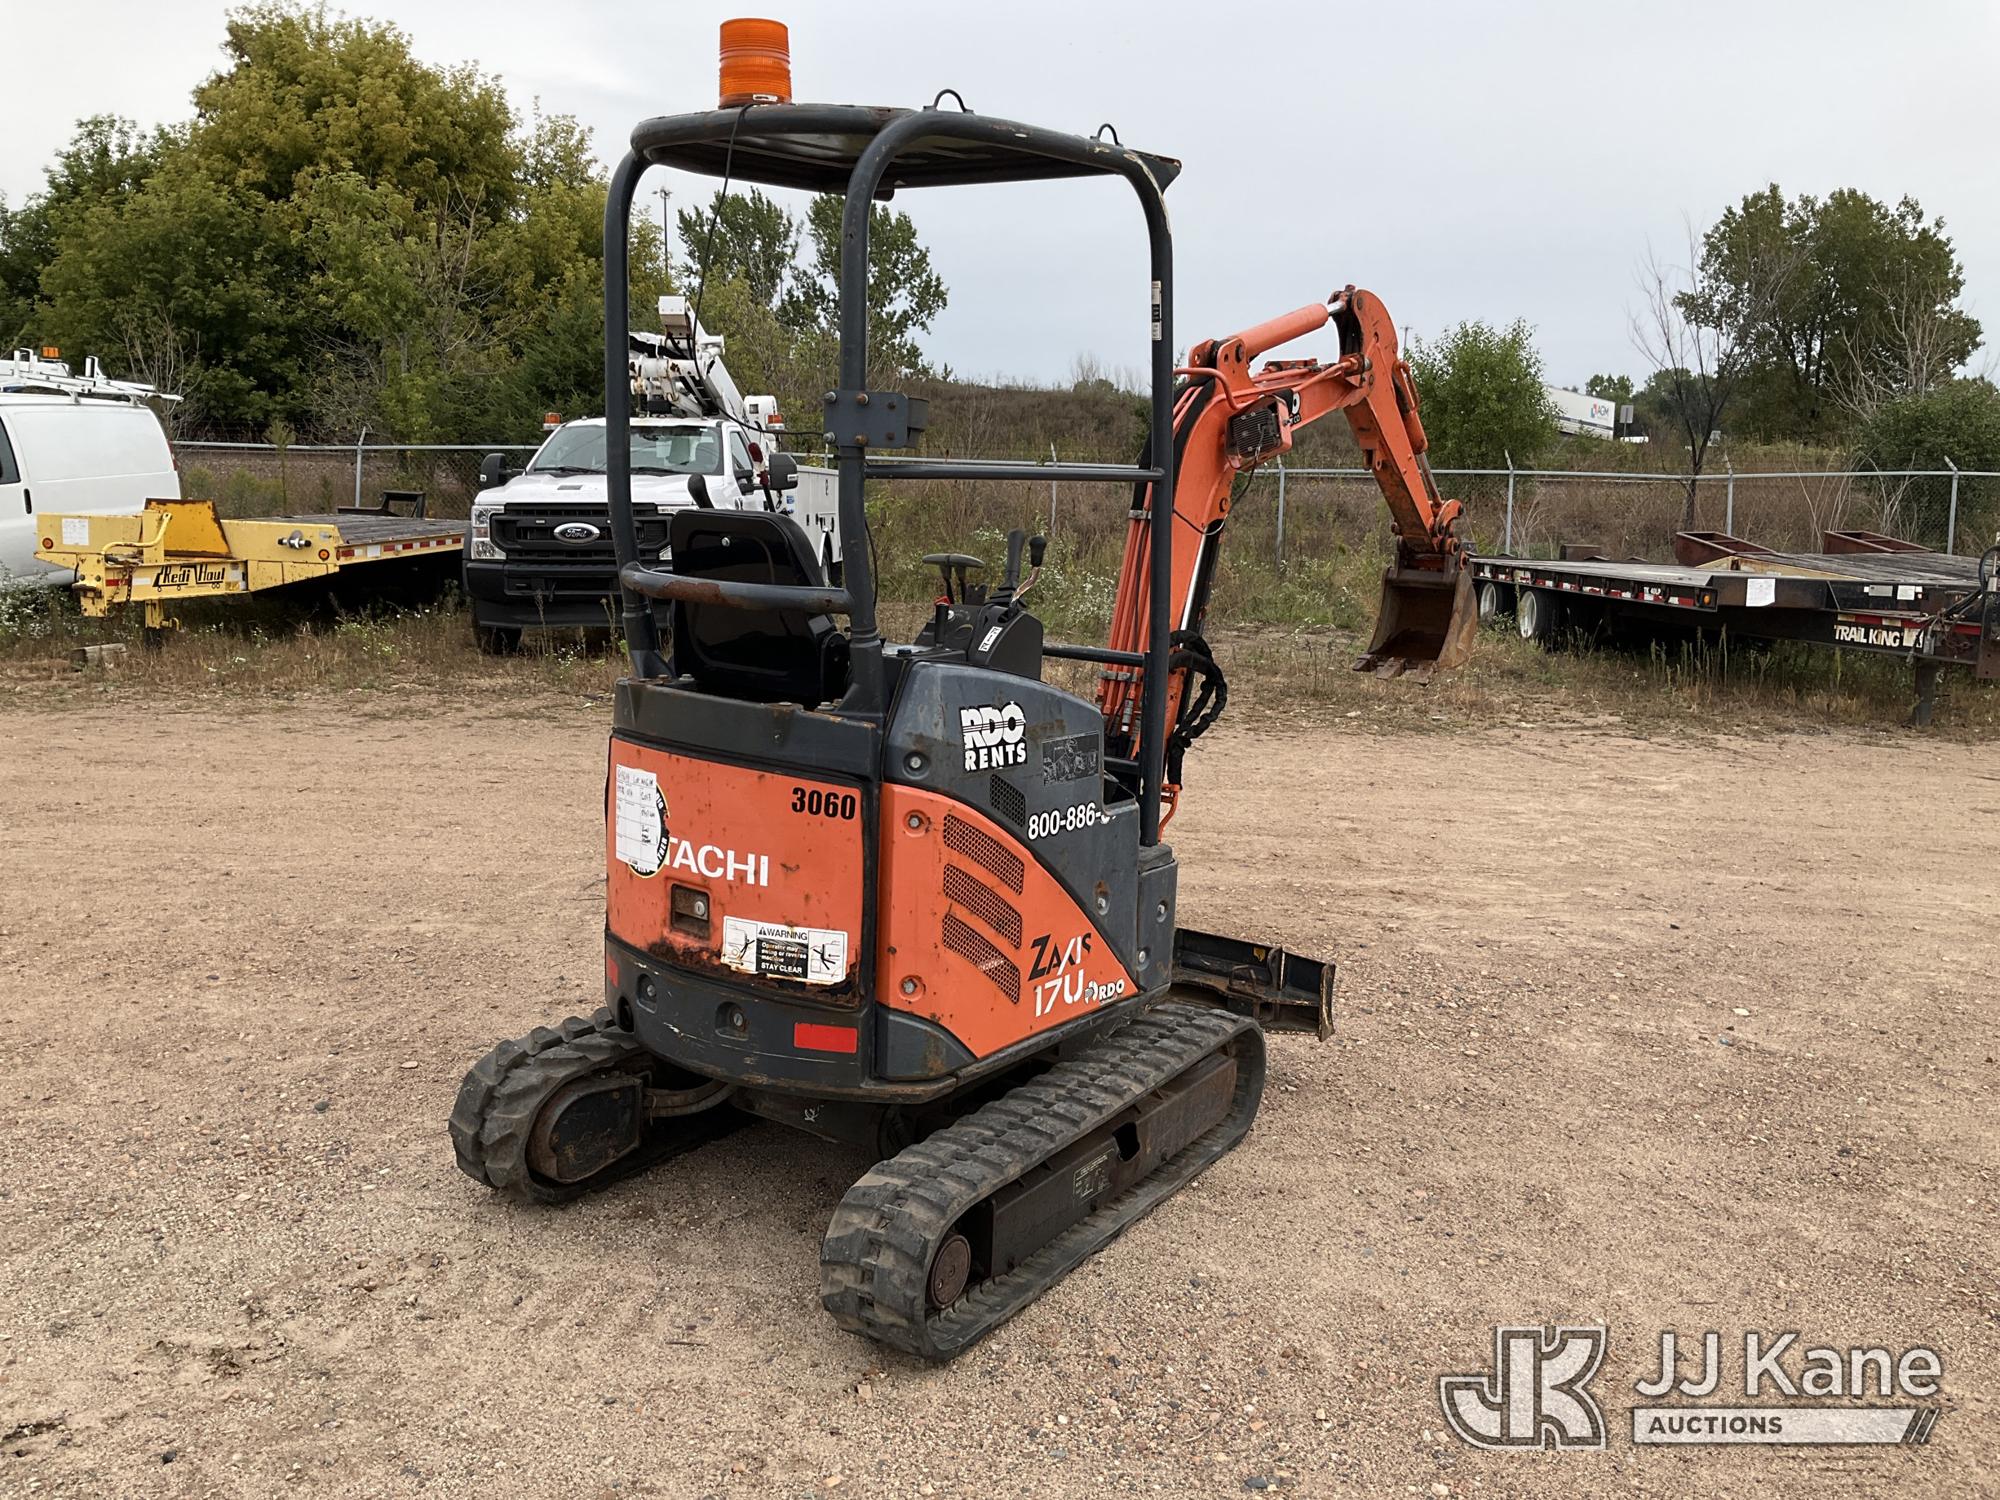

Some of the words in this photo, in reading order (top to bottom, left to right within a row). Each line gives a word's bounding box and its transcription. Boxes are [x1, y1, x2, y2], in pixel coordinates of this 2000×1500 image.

[565, 528, 587, 538] Ford
[162, 565, 191, 584] Redi
[198, 563, 226, 582] Haul
[960, 701, 1026, 749] RDO
[964, 742, 1027, 771] RENTS
[791, 787, 856, 820] 3060
[664, 836, 769, 886] TACHI
[767, 928, 808, 940] WARNING
[761, 962, 779, 970] STAY
[779, 964, 803, 972] CLEAR
[1034, 968, 1084, 1017] 17U
[1098, 978, 1125, 1001] RDO
